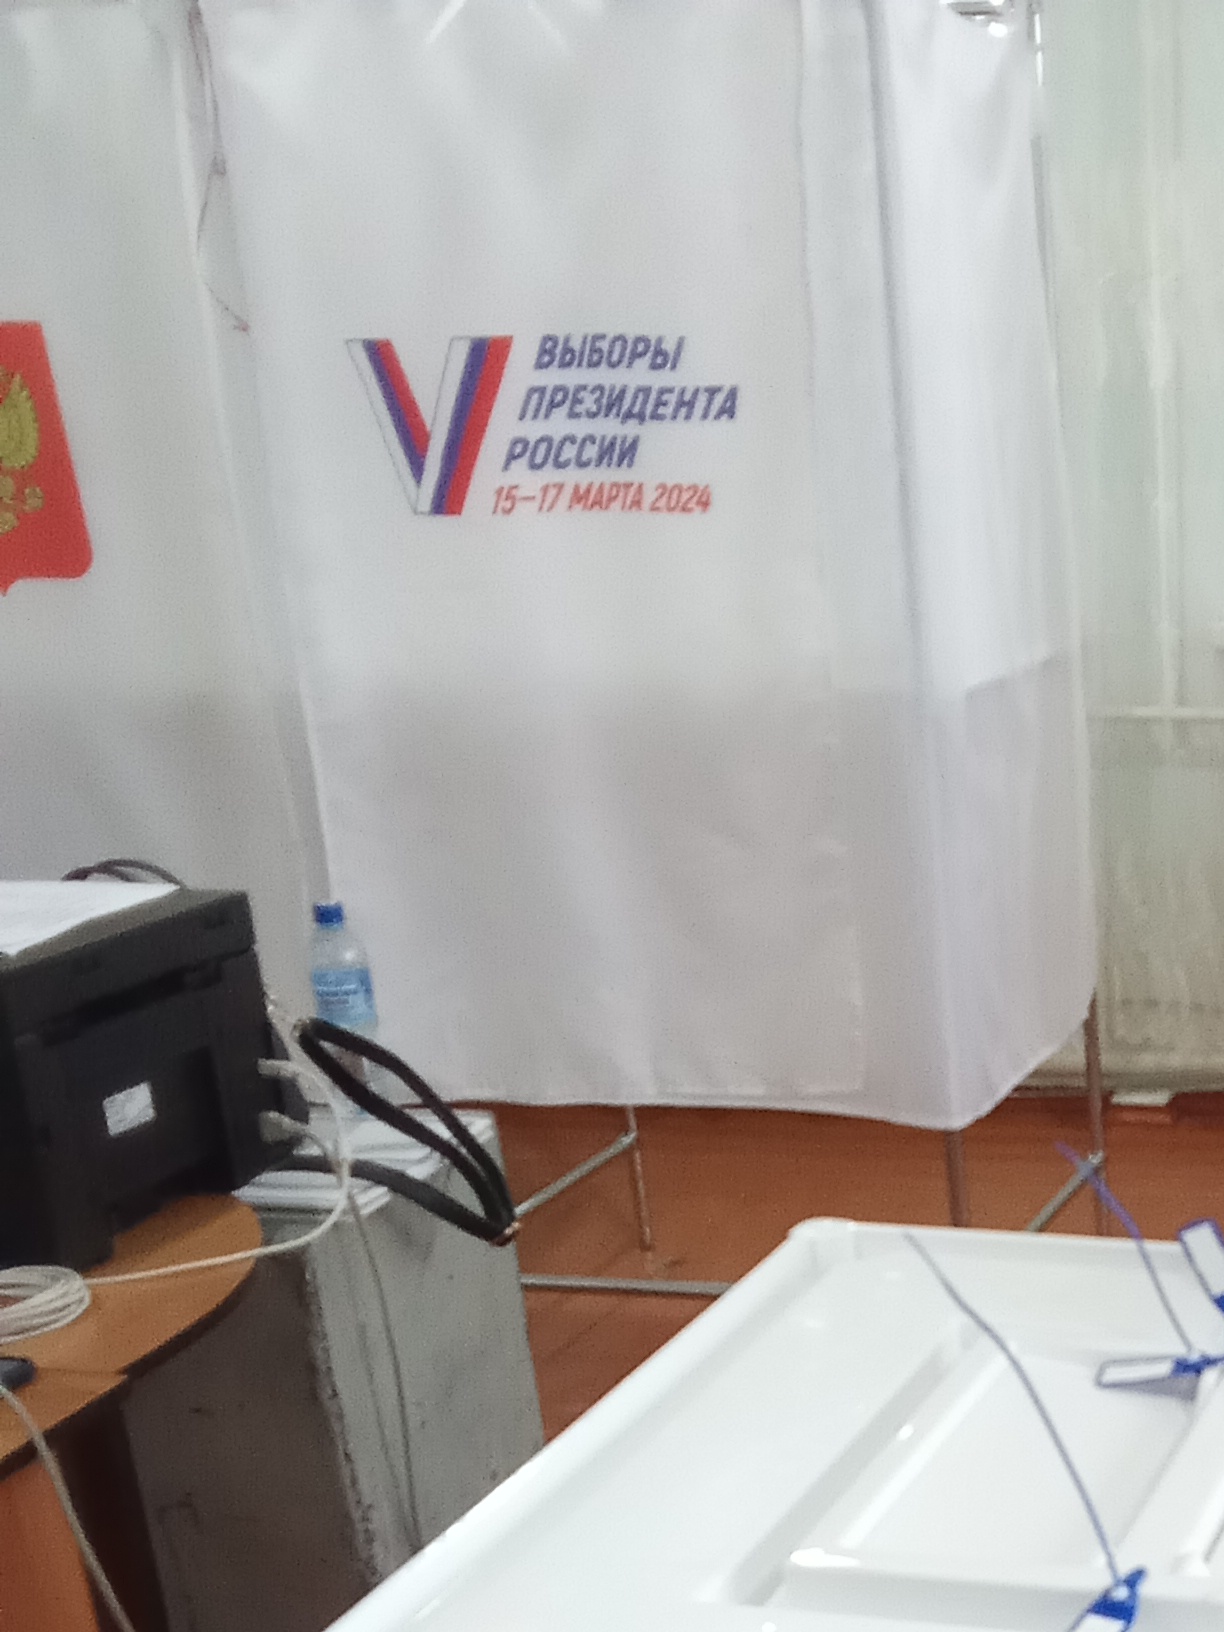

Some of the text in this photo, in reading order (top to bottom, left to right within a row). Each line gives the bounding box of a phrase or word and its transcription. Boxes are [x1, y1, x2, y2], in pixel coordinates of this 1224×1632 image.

[534, 333, 685, 371] ВЫБОРЫ
[518, 384, 738, 424] ПРЕЗИДЕНТА
[502, 434, 640, 472] РОССИИ
[570, 482, 646, 512] МАРТА
[649, 484, 713, 513] 2024
